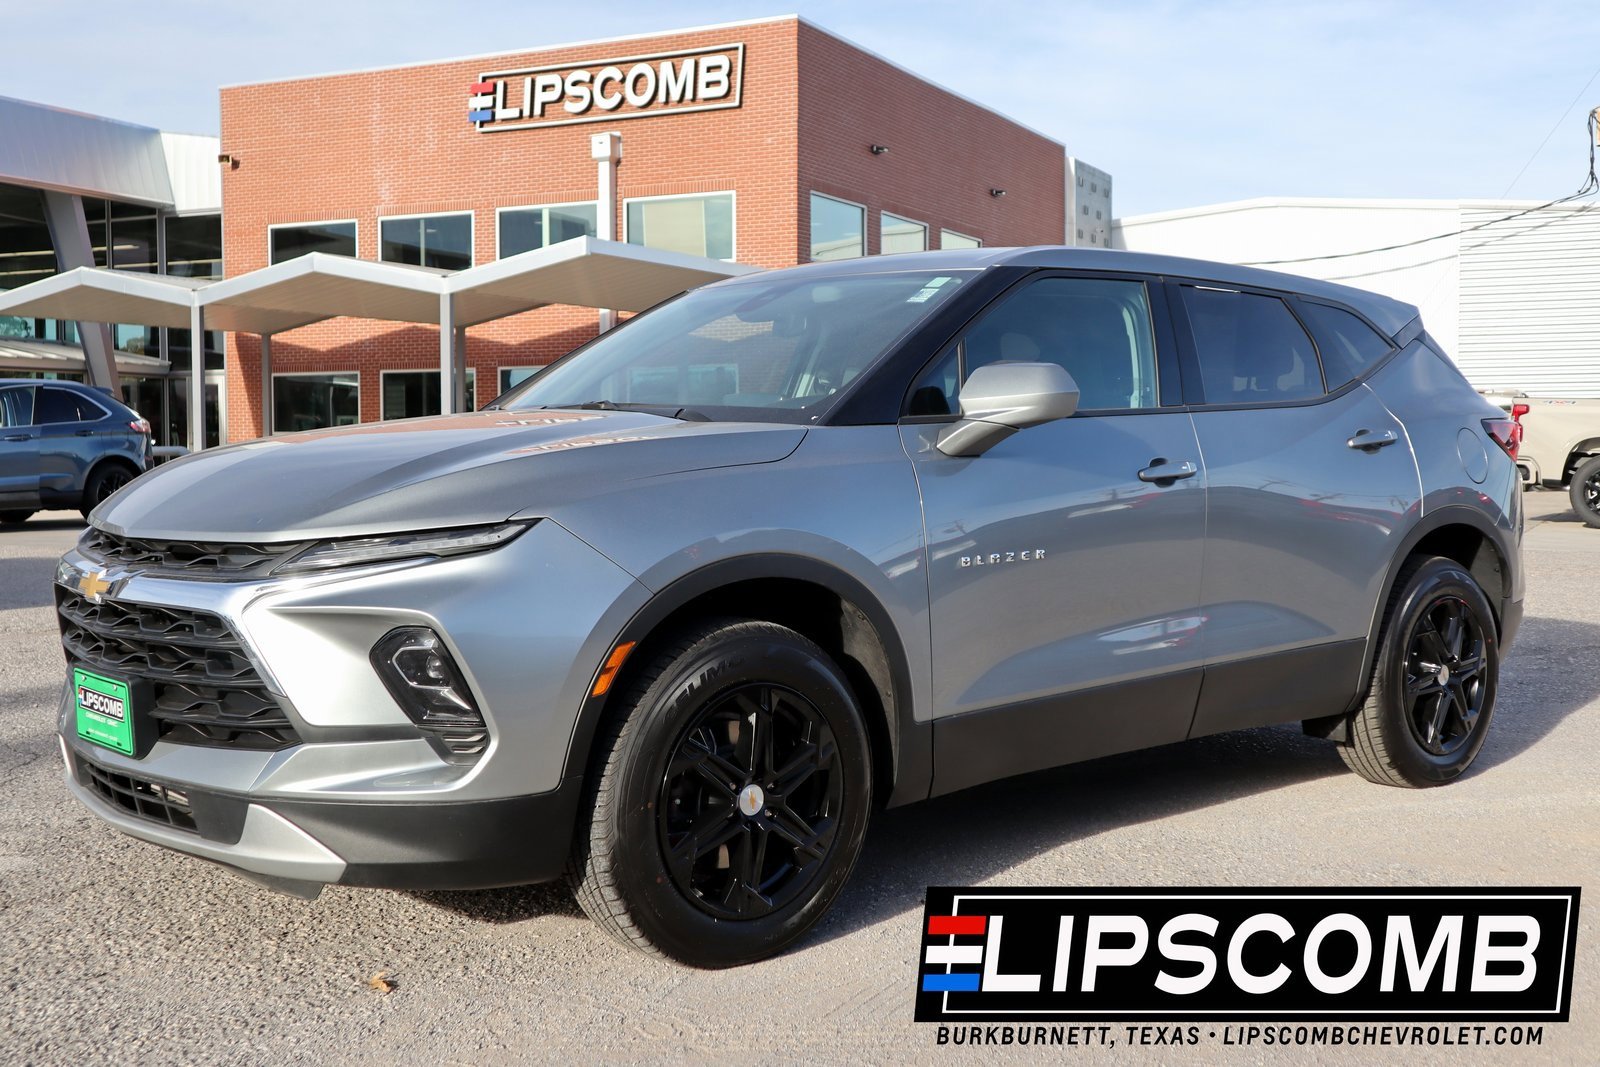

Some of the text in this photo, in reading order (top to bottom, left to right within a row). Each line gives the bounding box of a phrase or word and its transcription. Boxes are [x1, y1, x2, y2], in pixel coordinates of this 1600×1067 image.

[494, 54, 732, 121] LIPSCOMB
[961, 549, 1046, 568] BLAZER
[81, 689, 124, 719] LIPSCOMB
